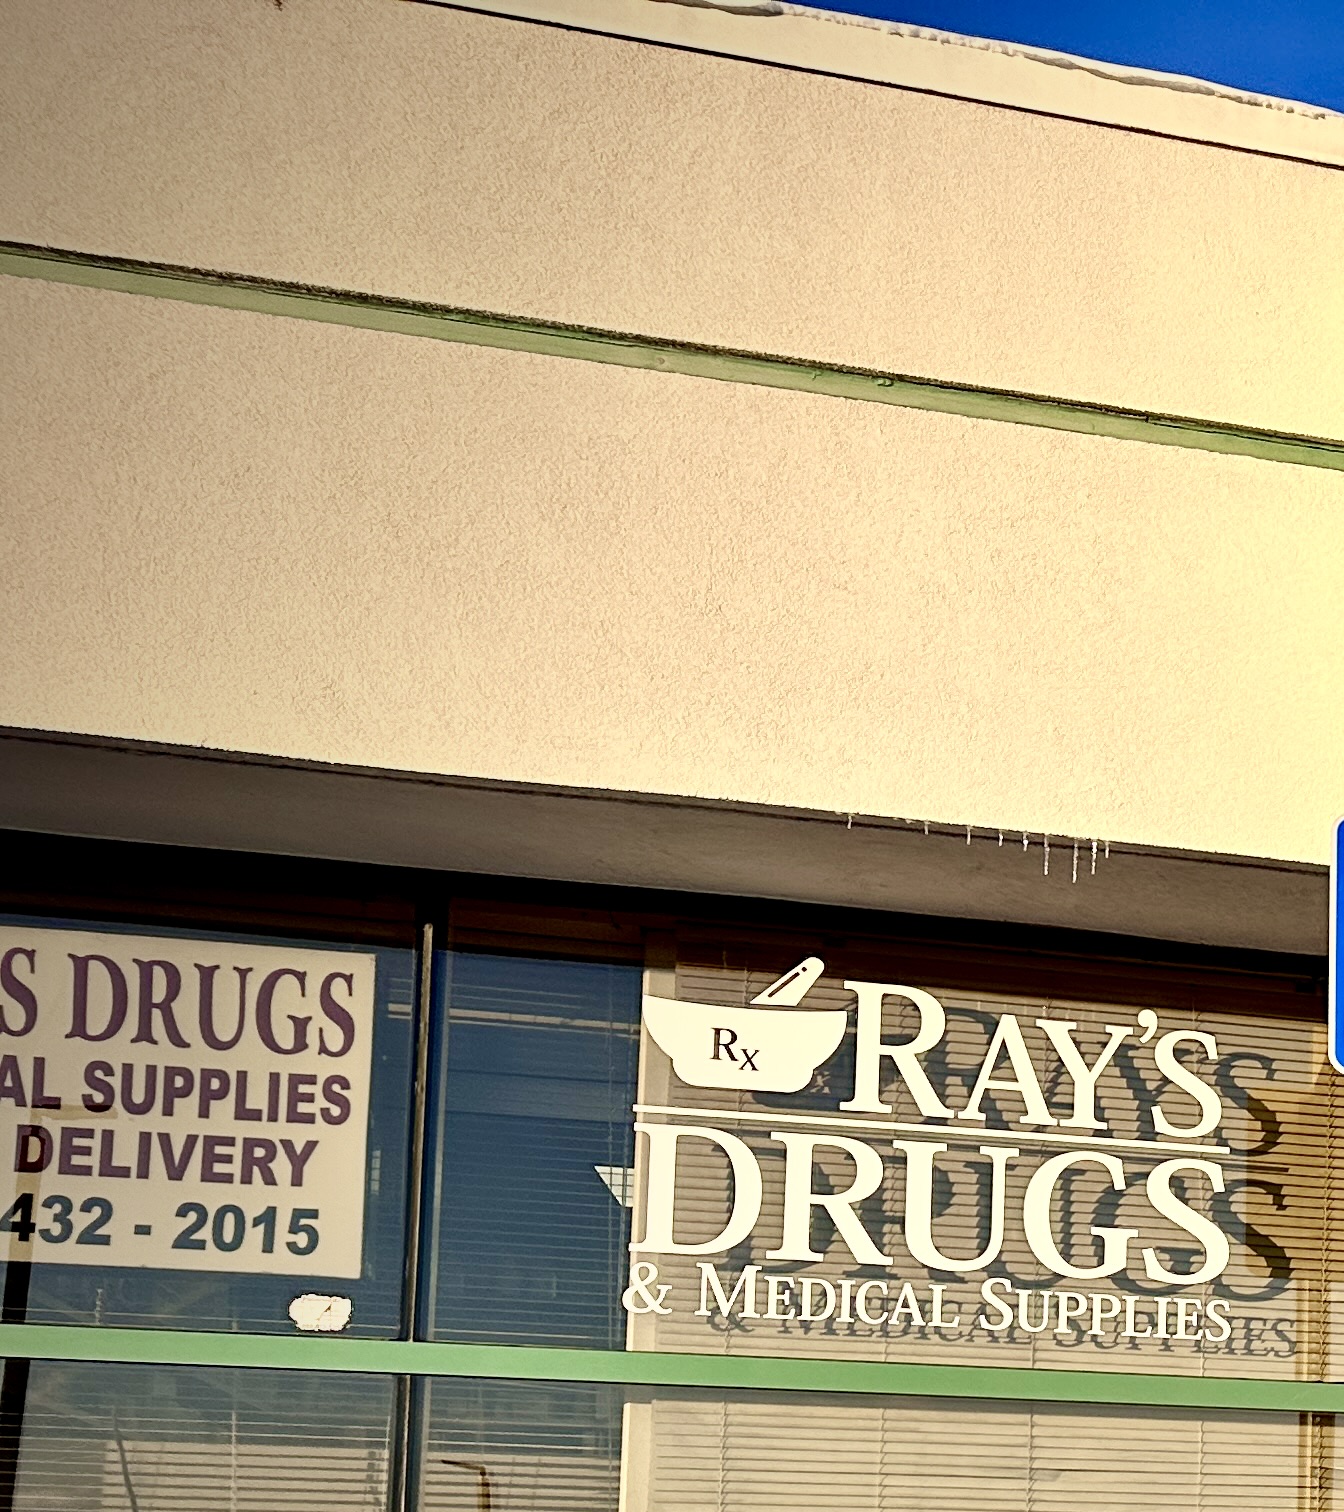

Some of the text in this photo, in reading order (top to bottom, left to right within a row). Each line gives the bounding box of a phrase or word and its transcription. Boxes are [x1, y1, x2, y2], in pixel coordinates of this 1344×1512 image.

[0, 947, 356, 1057] S DRUGS
[0, 1054, 351, 1125] AL SUPPLIES
[839, 979, 1223, 1139] RAY'S
[14, 1124, 320, 1187] DELIVERY
[0, 1193, 320, 1255] 432 - 2015
[629, 1120, 1231, 1286] DRUGS
[621, 1261, 1233, 1343] & MEDICAL SUPPLIES
